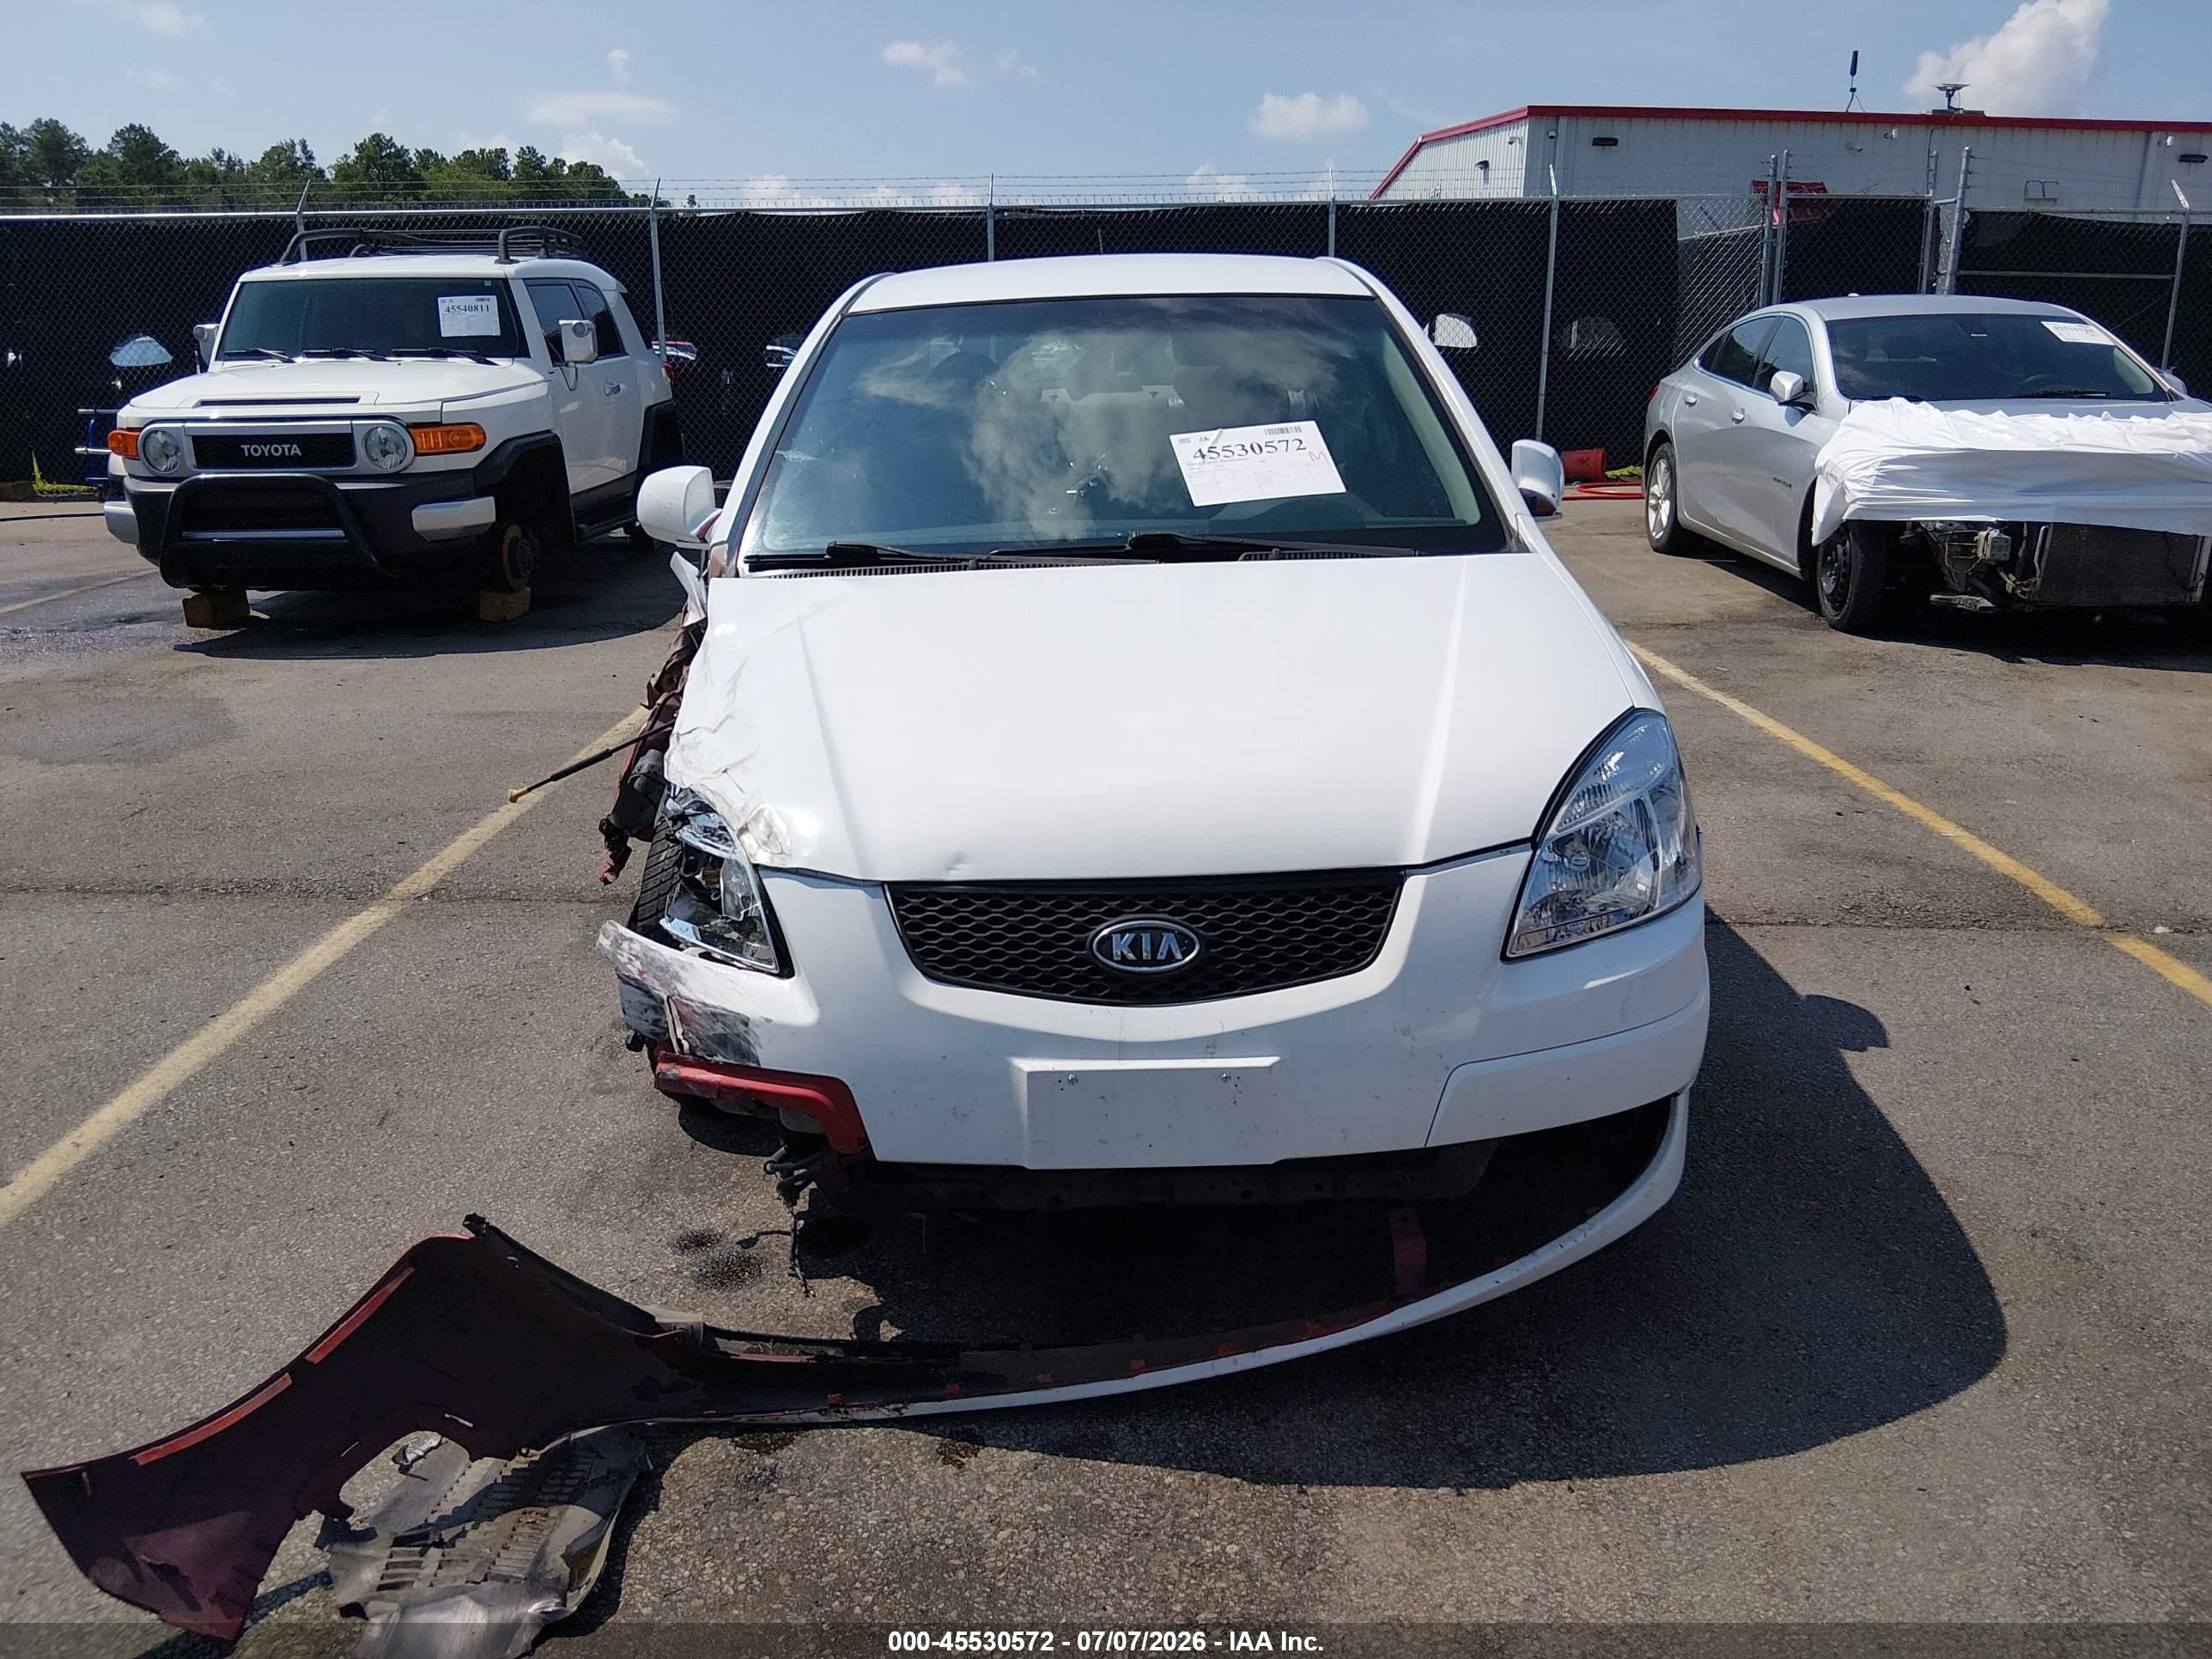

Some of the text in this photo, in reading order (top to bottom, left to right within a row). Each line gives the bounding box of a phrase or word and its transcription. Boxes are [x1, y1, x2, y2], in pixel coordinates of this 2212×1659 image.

[445, 304, 489, 313] 45540811
[240, 444, 301, 457] TOYOTA
[1193, 438, 1307, 460] 45530572
[1111, 933, 1182, 960] KIA
